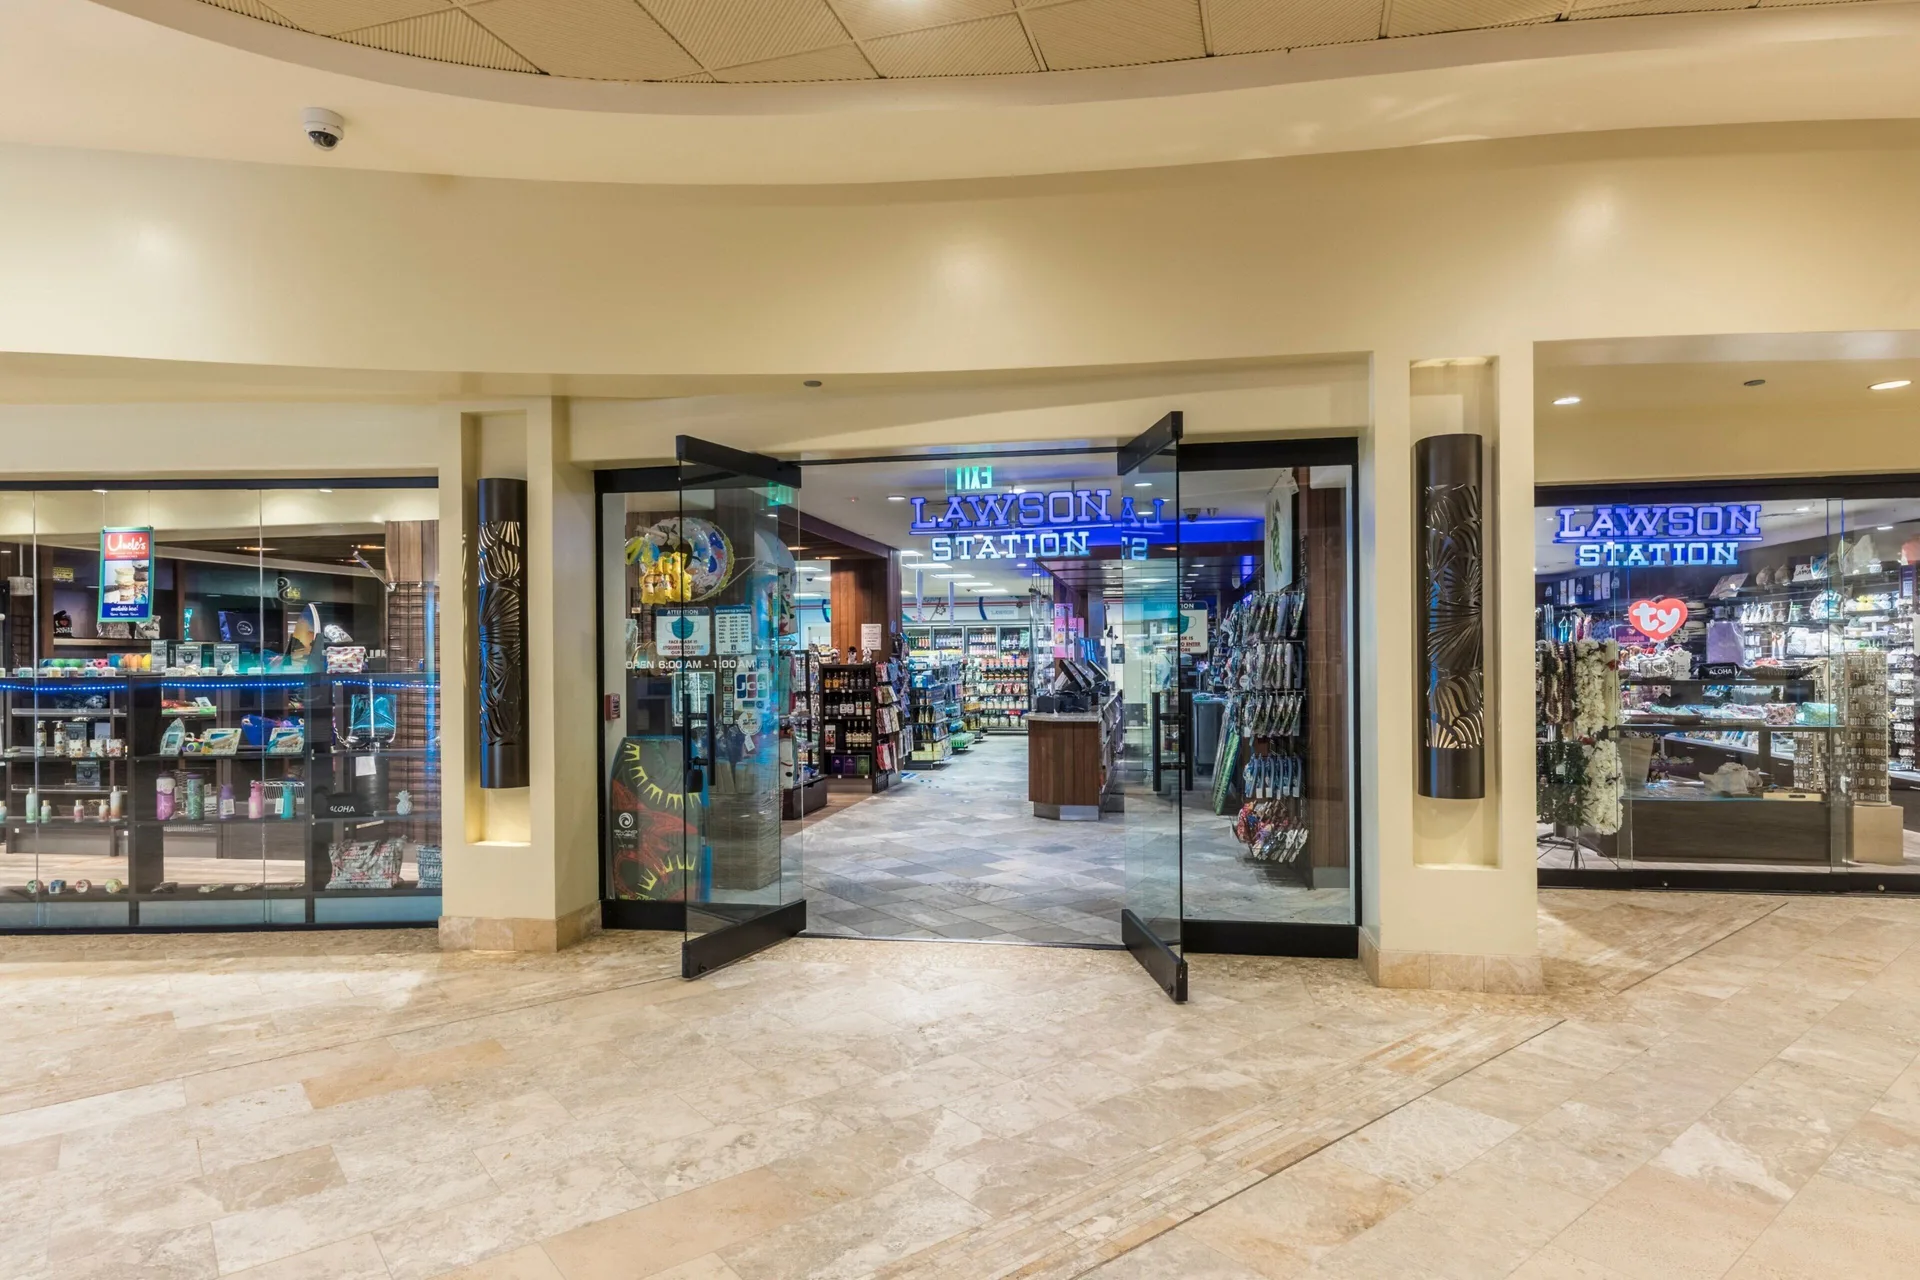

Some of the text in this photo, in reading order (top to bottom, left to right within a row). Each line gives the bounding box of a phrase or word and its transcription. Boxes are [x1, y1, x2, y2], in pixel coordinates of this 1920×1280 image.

[910, 488, 1112, 529] LAWSON
[1557, 504, 1762, 538] LAWSON
[931, 531, 1090, 562] STATION
[1577, 542, 1739, 567] STATION
[1632, 602, 1681, 634] ty
[625, 660, 655, 669] OPEN
[658, 660, 683, 669] 6:00
[685, 660, 702, 669] AM
[713, 660, 737, 669] 1:00
[737, 659, 756, 668] AM
[736, 682, 768, 691] JCB
[329, 805, 355, 813] ALOHA
